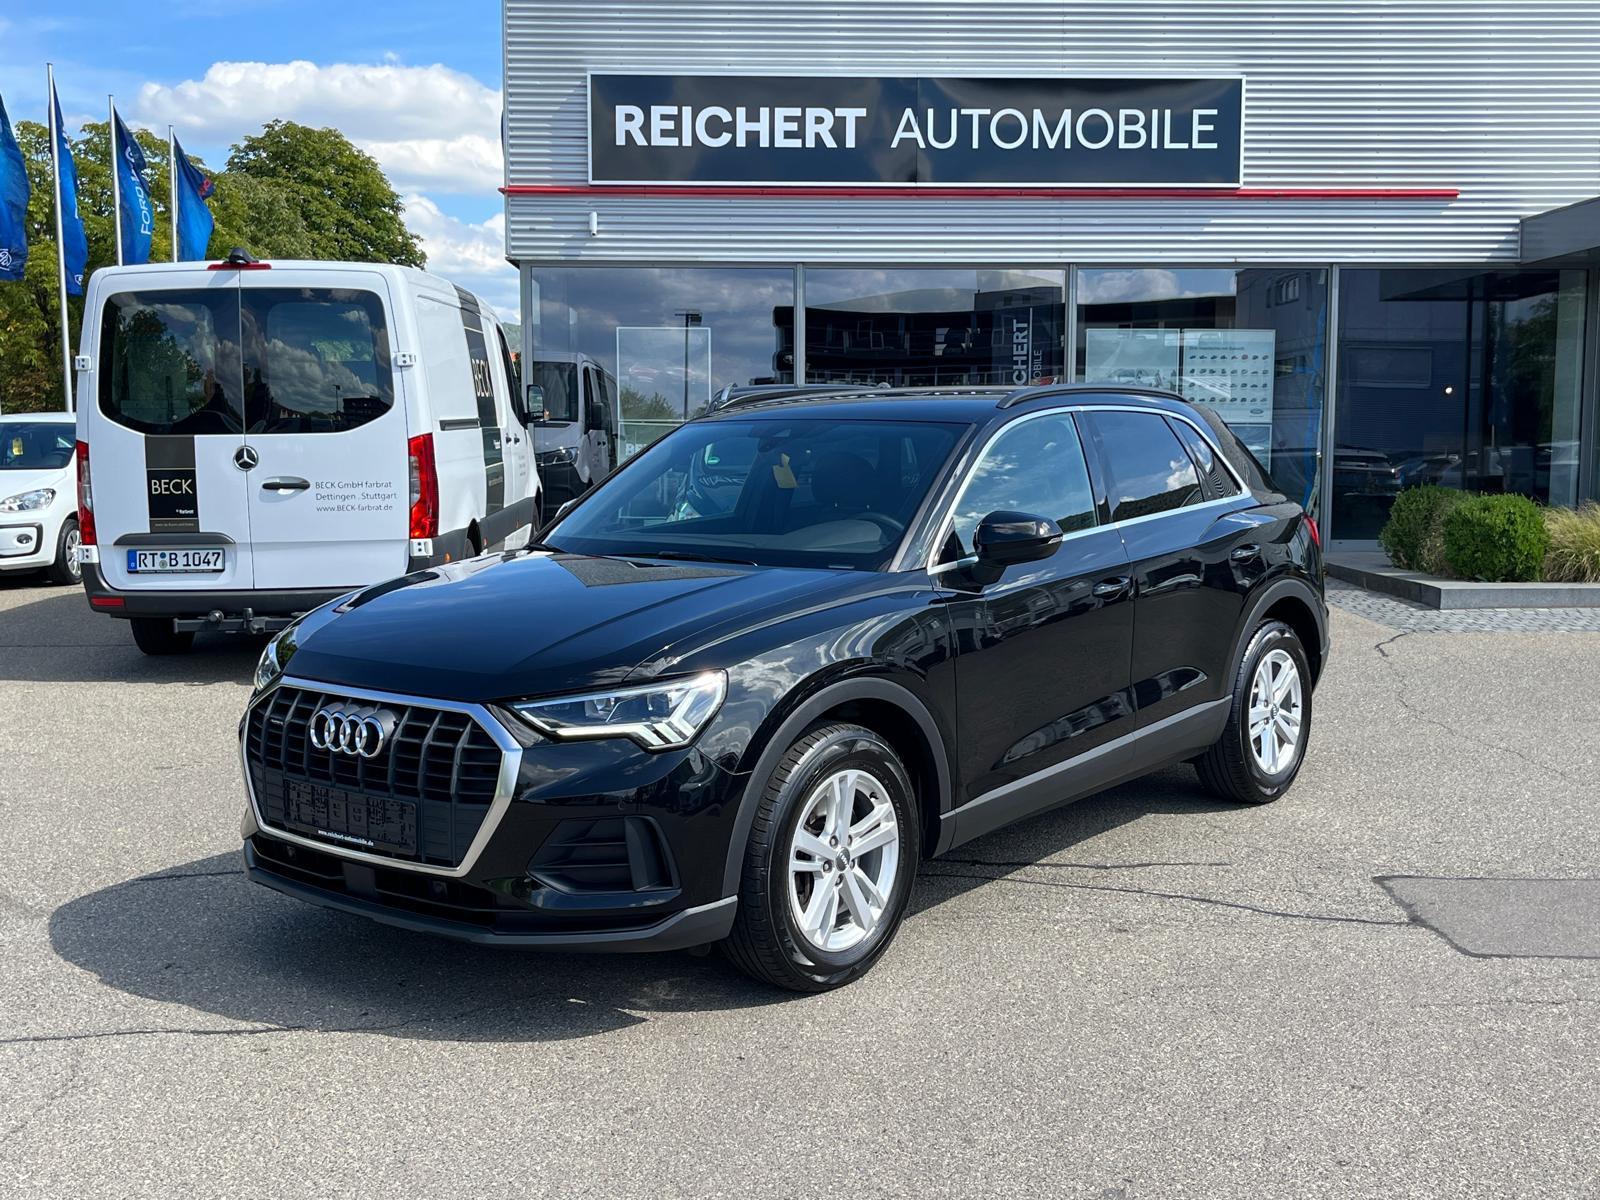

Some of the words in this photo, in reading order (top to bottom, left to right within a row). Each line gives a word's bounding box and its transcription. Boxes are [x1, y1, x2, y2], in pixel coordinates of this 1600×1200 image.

[615, 105, 866, 149] REICHERT
[890, 108, 1218, 150] AUTOMOBILE
[135, 186, 151, 235] FORD
[151, 479, 193, 494] BECK
[315, 481, 336, 489] BECK
[338, 481, 363, 489] GmbH
[365, 480, 392, 488] farbrat
[315, 493, 356, 502] Dettingen
[361, 492, 397, 501] Stuttgart
[316, 504, 393, 512] www.BECK-farbrat.de
[138, 552, 158, 568] RT
[169, 552, 179, 567] B
[182, 552, 221, 567] 1047
